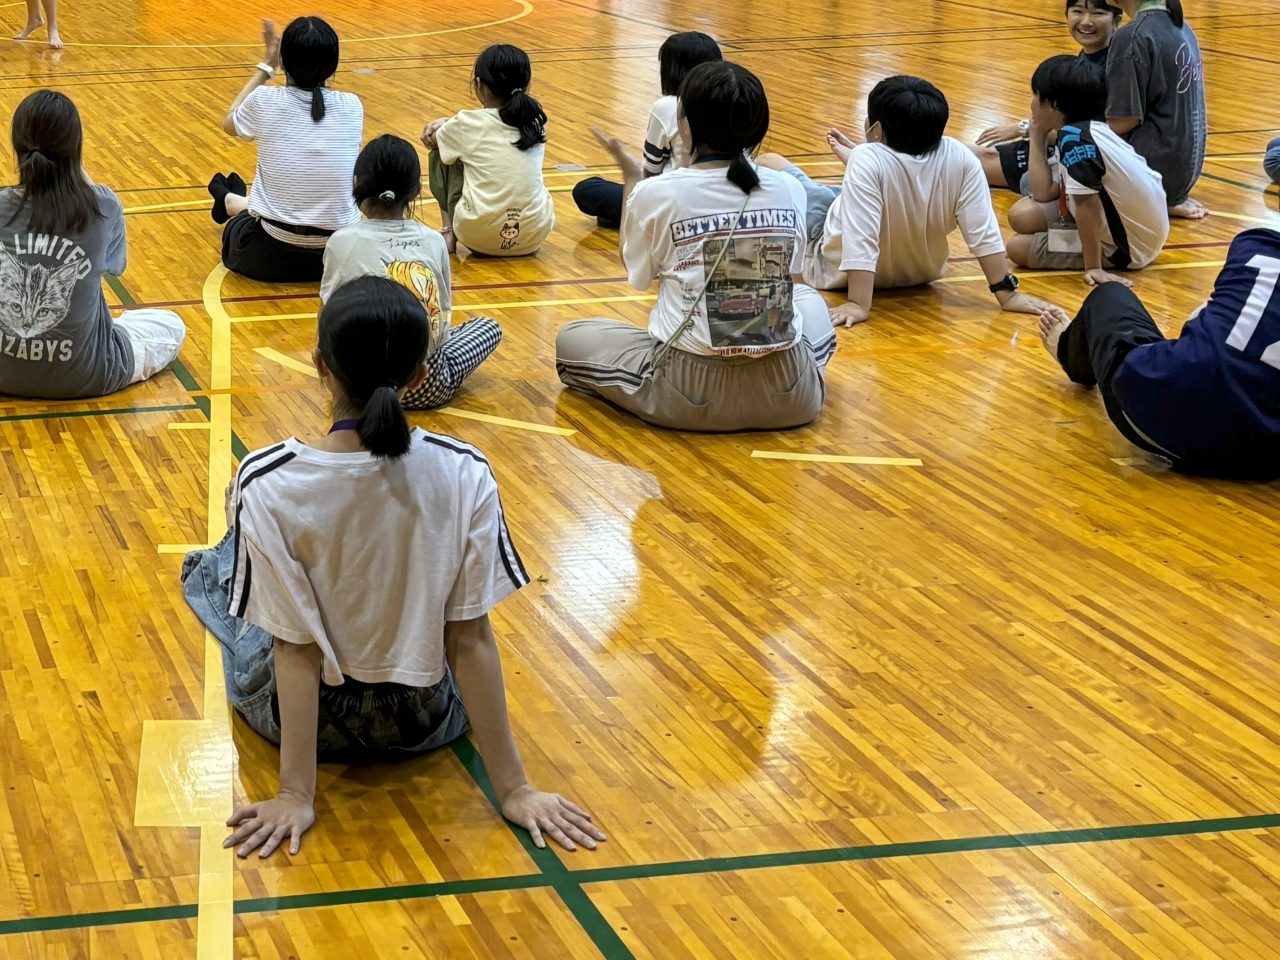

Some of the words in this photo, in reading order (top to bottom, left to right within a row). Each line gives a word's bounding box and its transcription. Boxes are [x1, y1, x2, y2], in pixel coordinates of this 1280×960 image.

[671, 210, 741, 239] BETTER
[745, 208, 795, 228] TIMES
[14, 232, 92, 280] LIMITED
